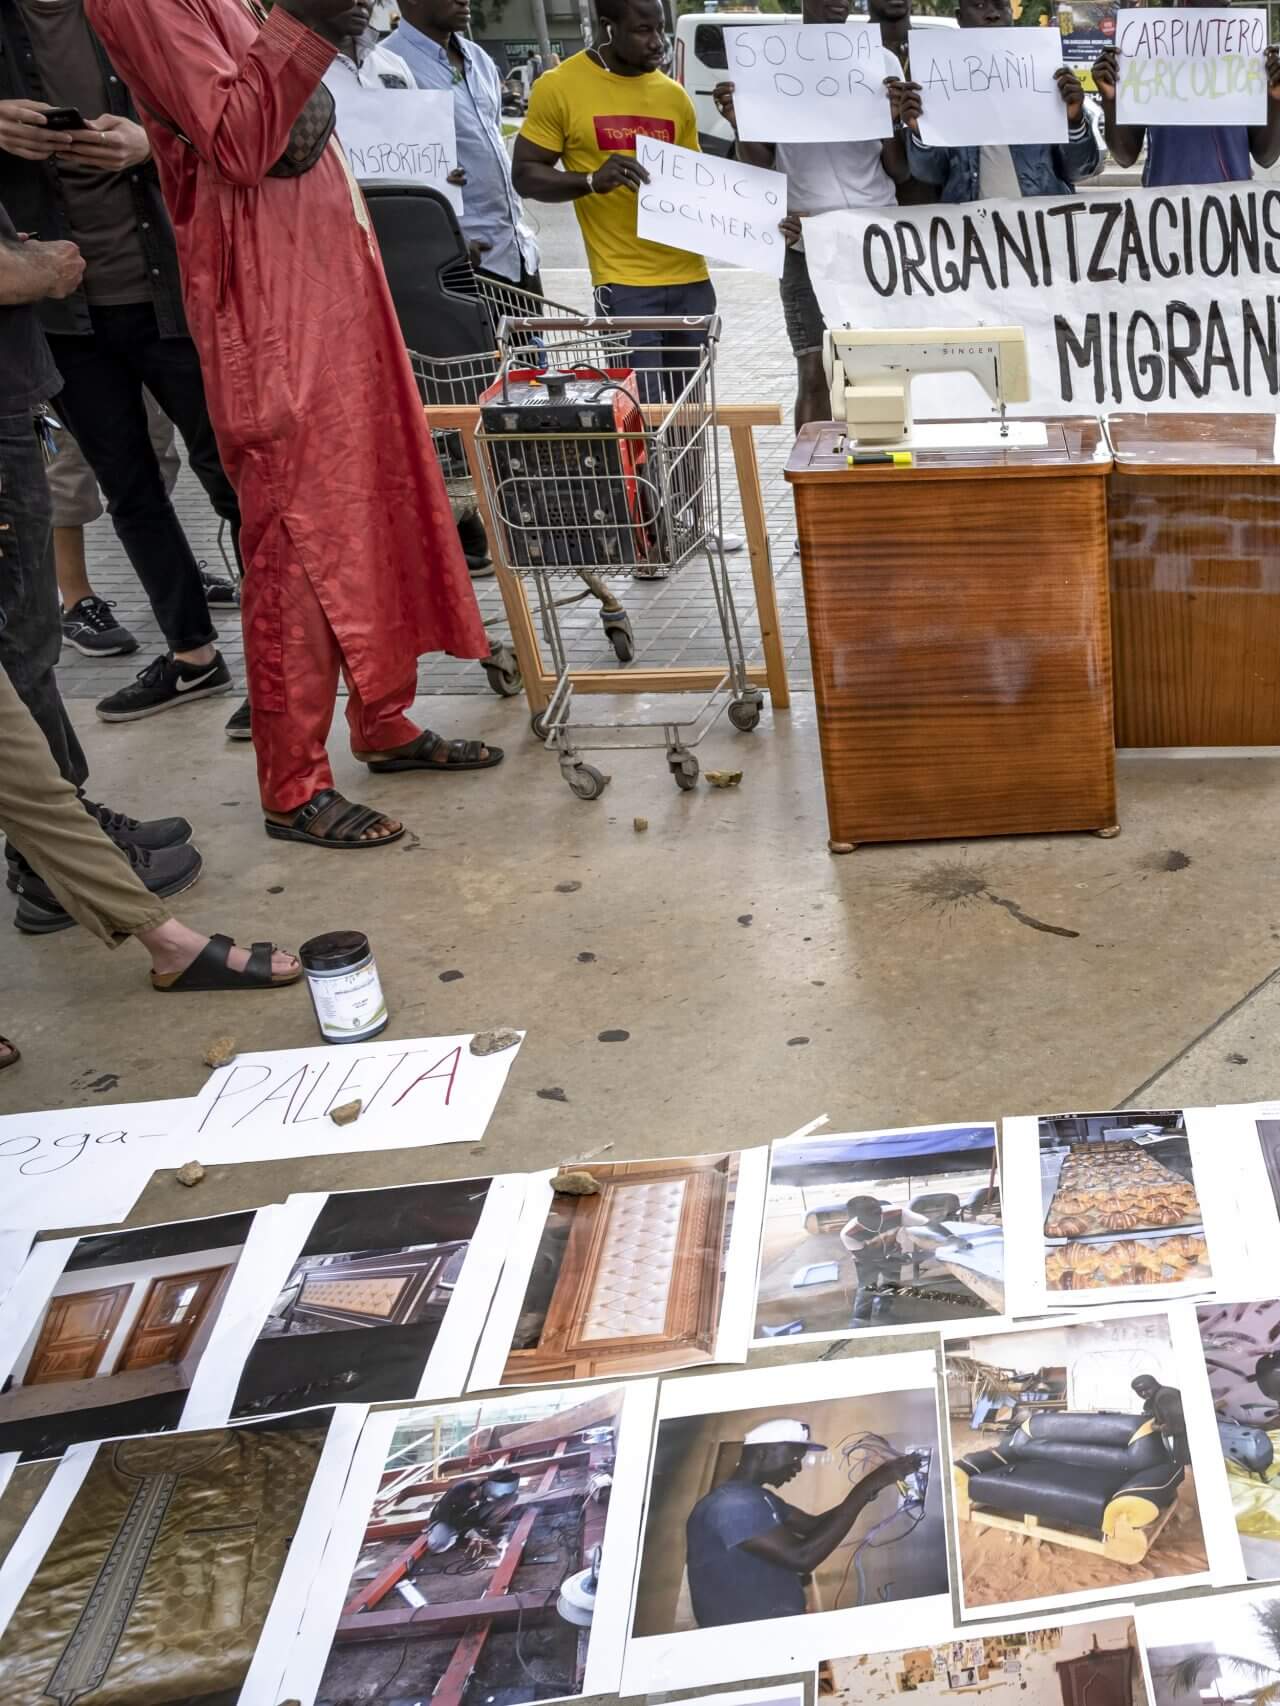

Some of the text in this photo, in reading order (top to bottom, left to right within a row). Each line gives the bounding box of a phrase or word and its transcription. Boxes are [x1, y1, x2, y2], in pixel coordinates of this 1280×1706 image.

[1120, 18, 1264, 59] CARPINTERO
[773, 68, 875, 96] DOR
[641, 144, 777, 205] MEDICO
[943, 347, 993, 355] SINGER
[198, 1046, 462, 1133] PALETA
